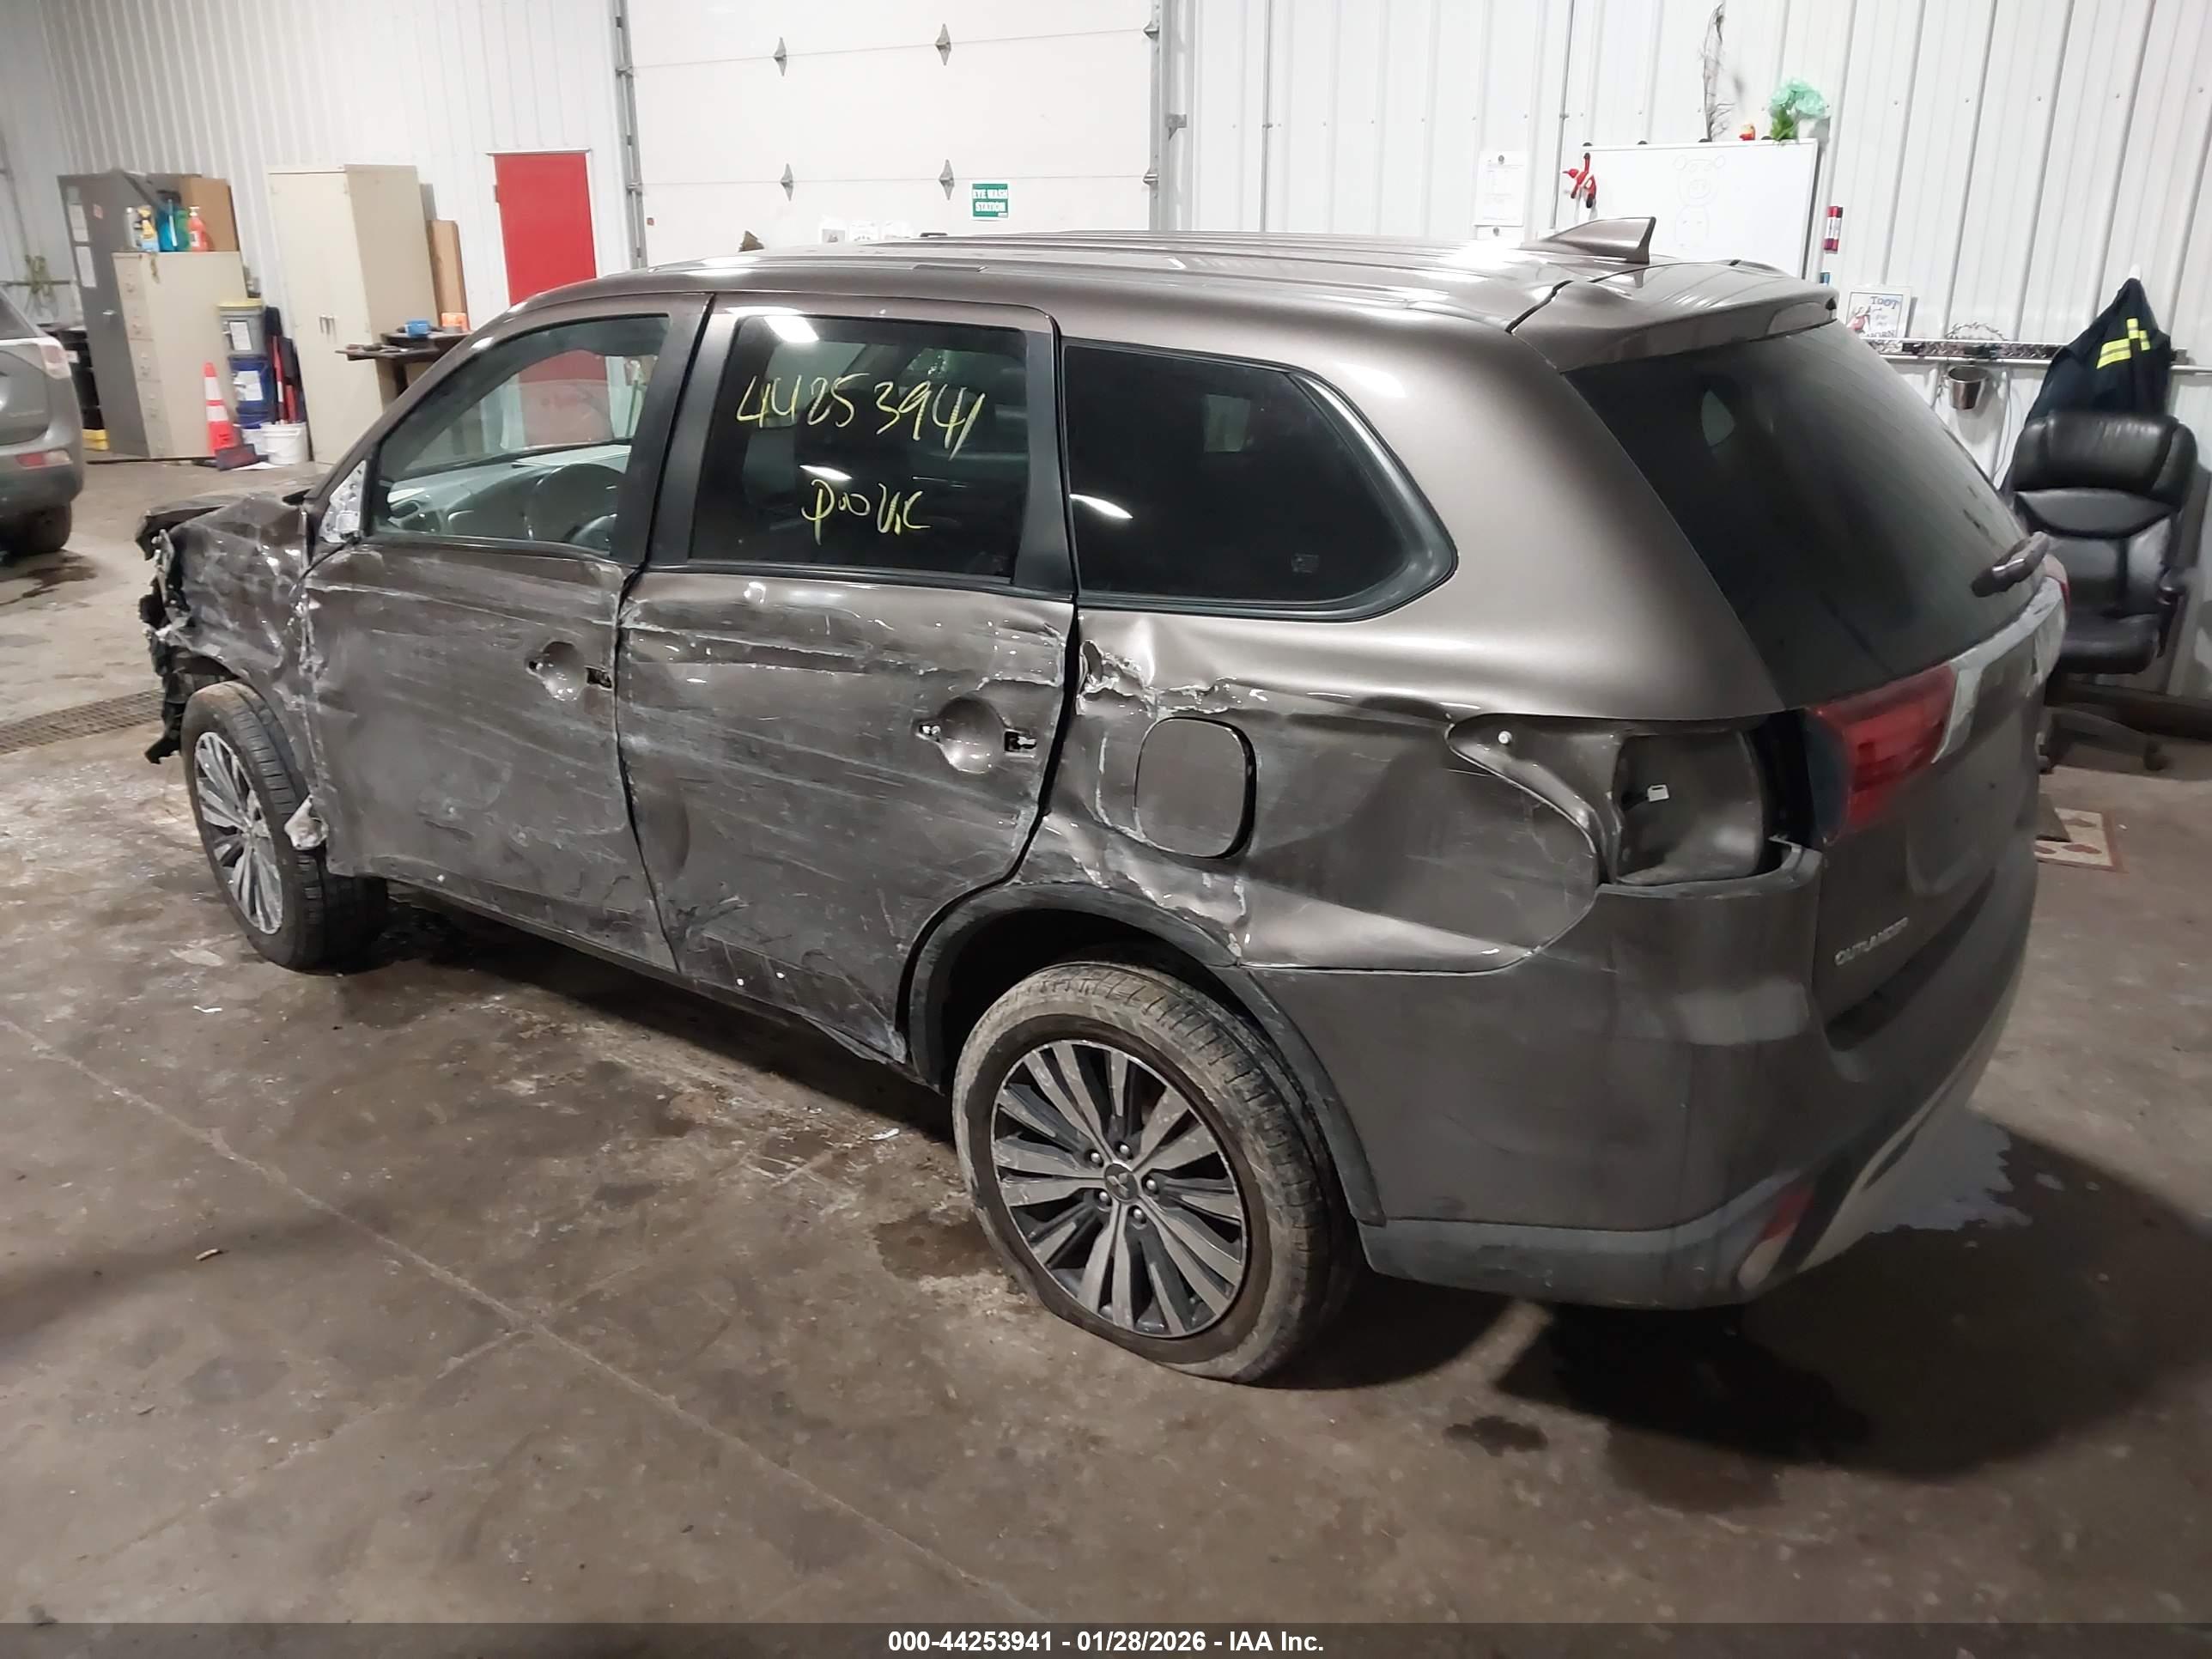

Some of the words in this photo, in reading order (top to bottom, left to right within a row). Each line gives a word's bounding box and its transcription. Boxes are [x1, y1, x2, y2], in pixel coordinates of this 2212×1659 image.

[972, 189, 987, 198] EYE
[988, 189, 1008, 198] WASH
[975, 201, 1006, 212] STATION
